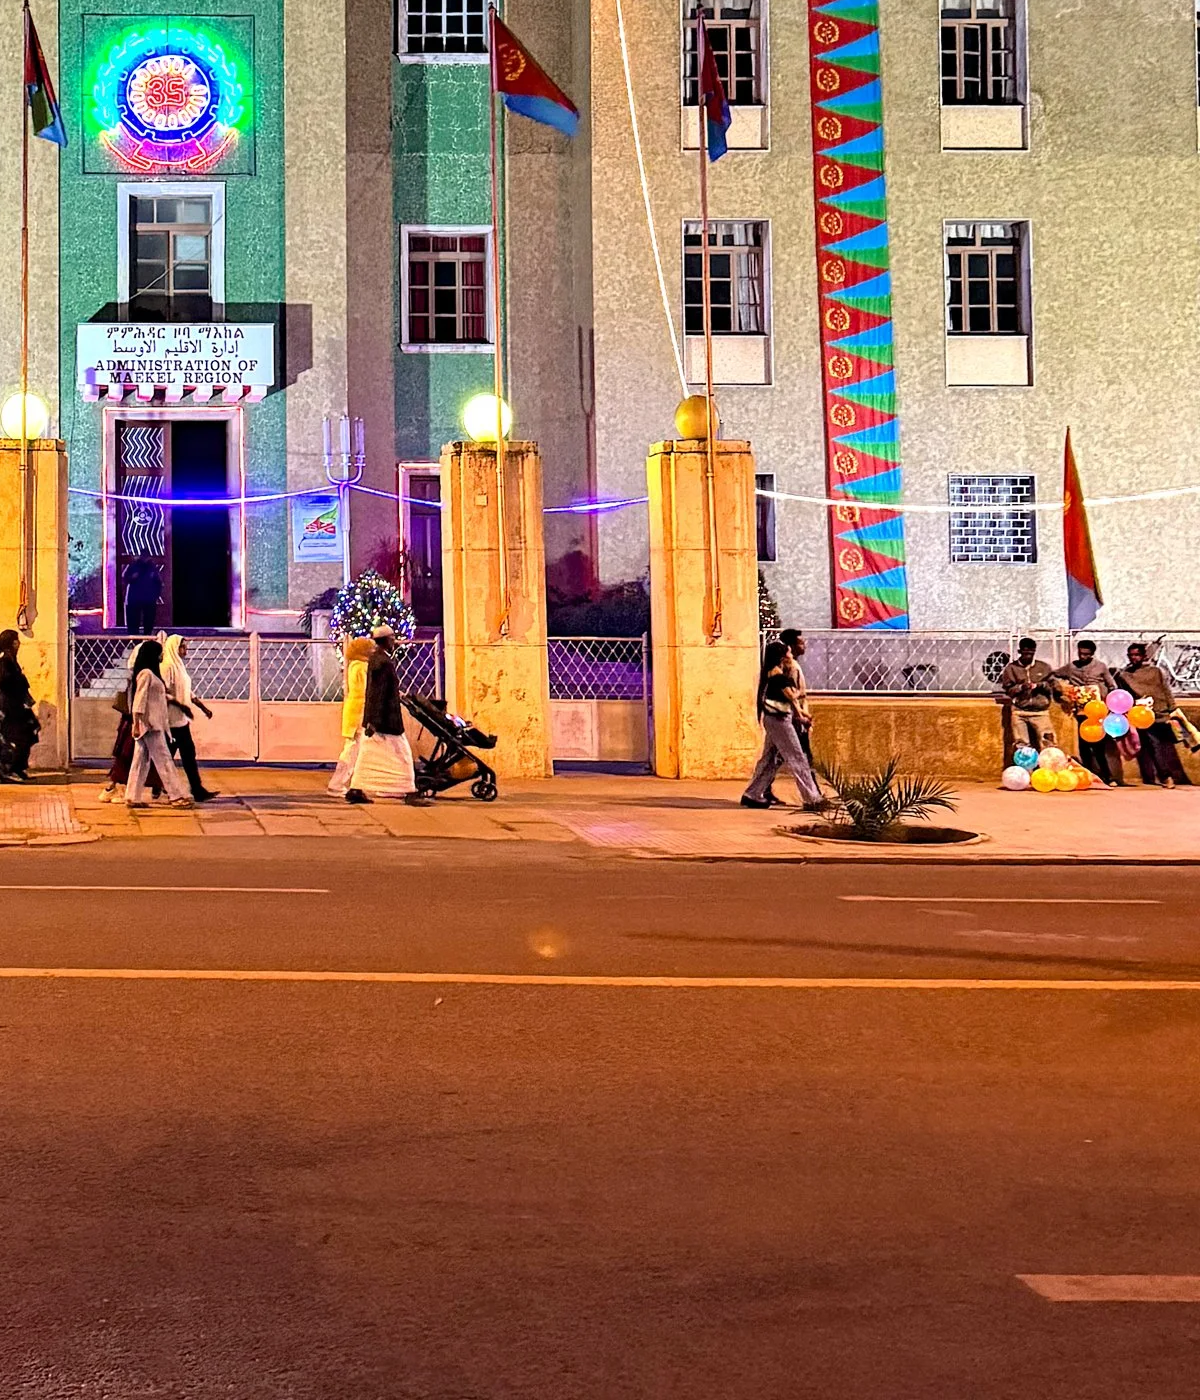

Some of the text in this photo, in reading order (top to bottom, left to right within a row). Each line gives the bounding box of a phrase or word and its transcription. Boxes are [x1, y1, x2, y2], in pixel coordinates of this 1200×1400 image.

[147, 77, 186, 107] 35
[94, 359, 258, 371] ADMINISTRATION OF
[109, 372, 243, 384] MAEKEL REGION
